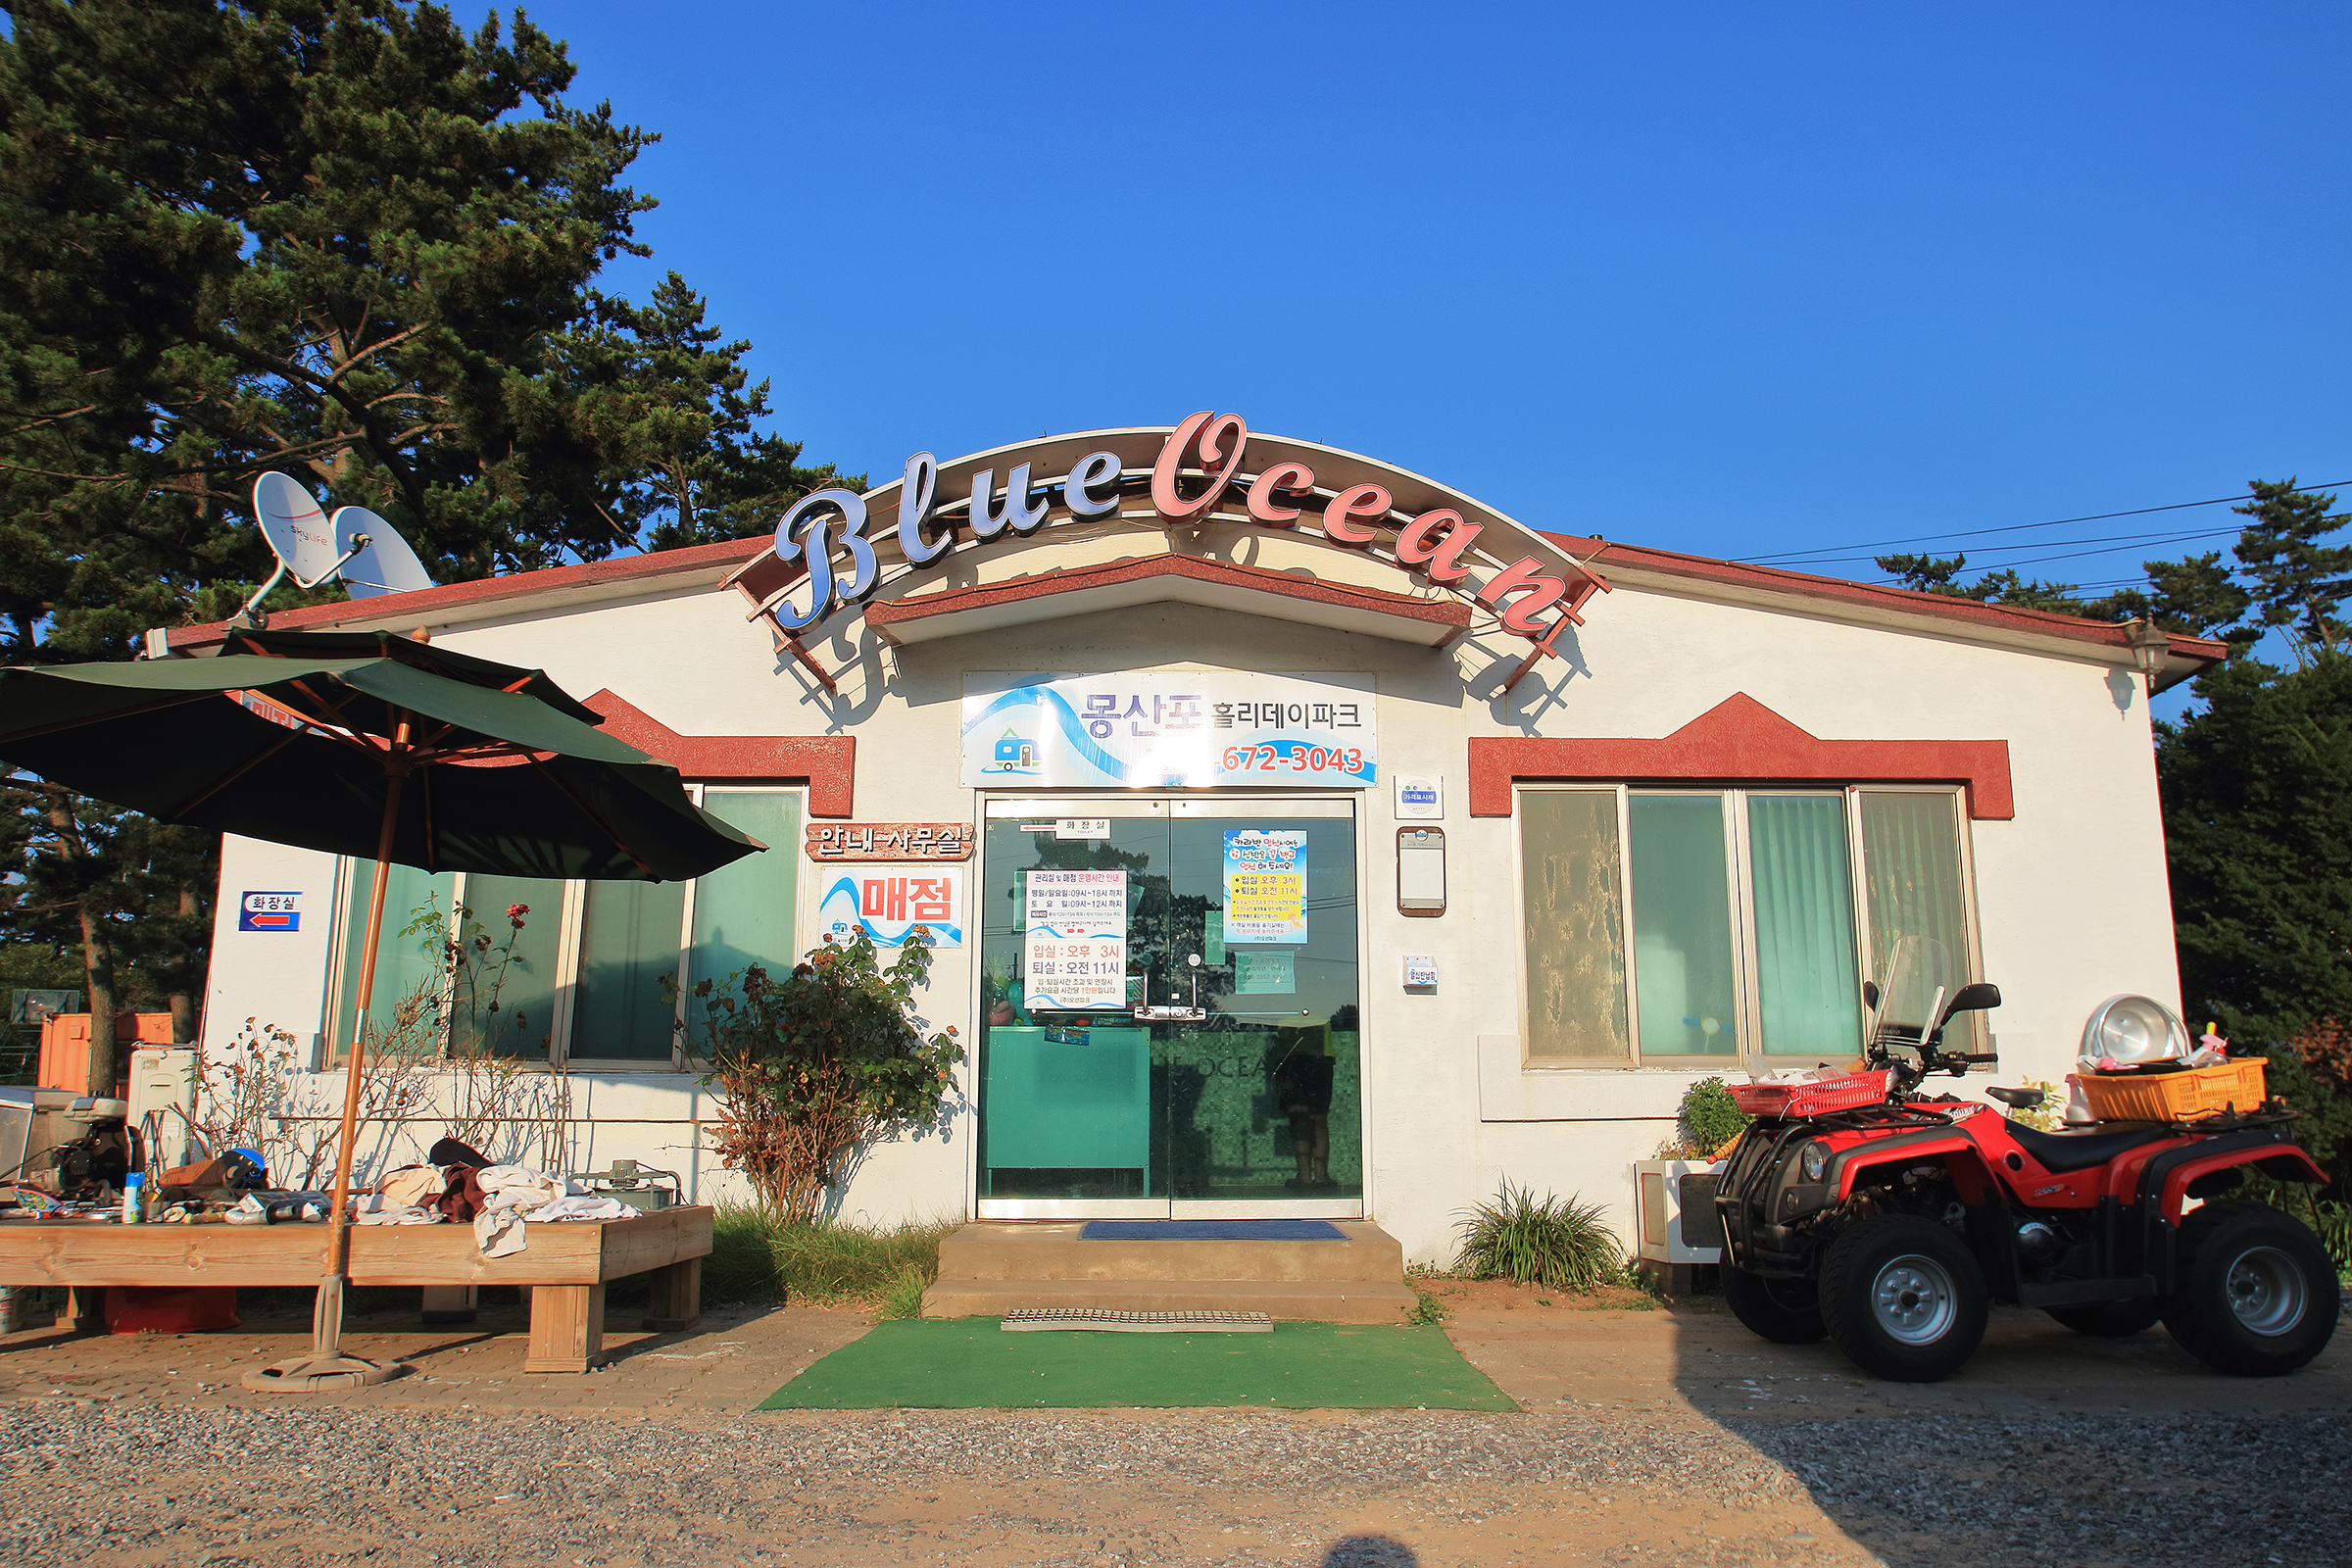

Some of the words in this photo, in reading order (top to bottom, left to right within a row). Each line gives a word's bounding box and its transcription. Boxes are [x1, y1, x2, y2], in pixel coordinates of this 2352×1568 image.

[774, 450, 1122, 633] Blue
[1151, 410, 1566, 637] Ocean
[290, 524, 328, 547] skylife
[1080, 694, 1202, 739] 몽산포
[1211, 702, 1363, 730] 홀리데이파크
[819, 824, 875, 854] 안내
[887, 826, 963, 854] 사무실
[1035, 873, 1055, 883] 관리실
[1063, 873, 1077, 883] 매점
[1078, 873, 1105, 883] 운영시간
[1105, 873, 1120, 882] 안내
[1241, 876, 1258, 885] 입실
[1261, 876, 1278, 885] 오후
[1283, 876, 1297, 885] 3시
[1108, 889, 1123, 898] 까지
[1241, 887, 1258, 896] 퇴실
[1261, 887, 1278, 896] 오전
[1281, 887, 1298, 896] 11시
[252, 896, 295, 910] 화장실
[862, 877, 952, 921] 매점
[1108, 900, 1122, 908] 까지
[1033, 944, 1055, 958] 입실
[1067, 944, 1091, 958] 오후
[1100, 944, 1119, 958] 3시
[1032, 961, 1055, 975] 퇴실
[1066, 961, 1089, 975] 오전
[1093, 961, 1119, 975] 11시
